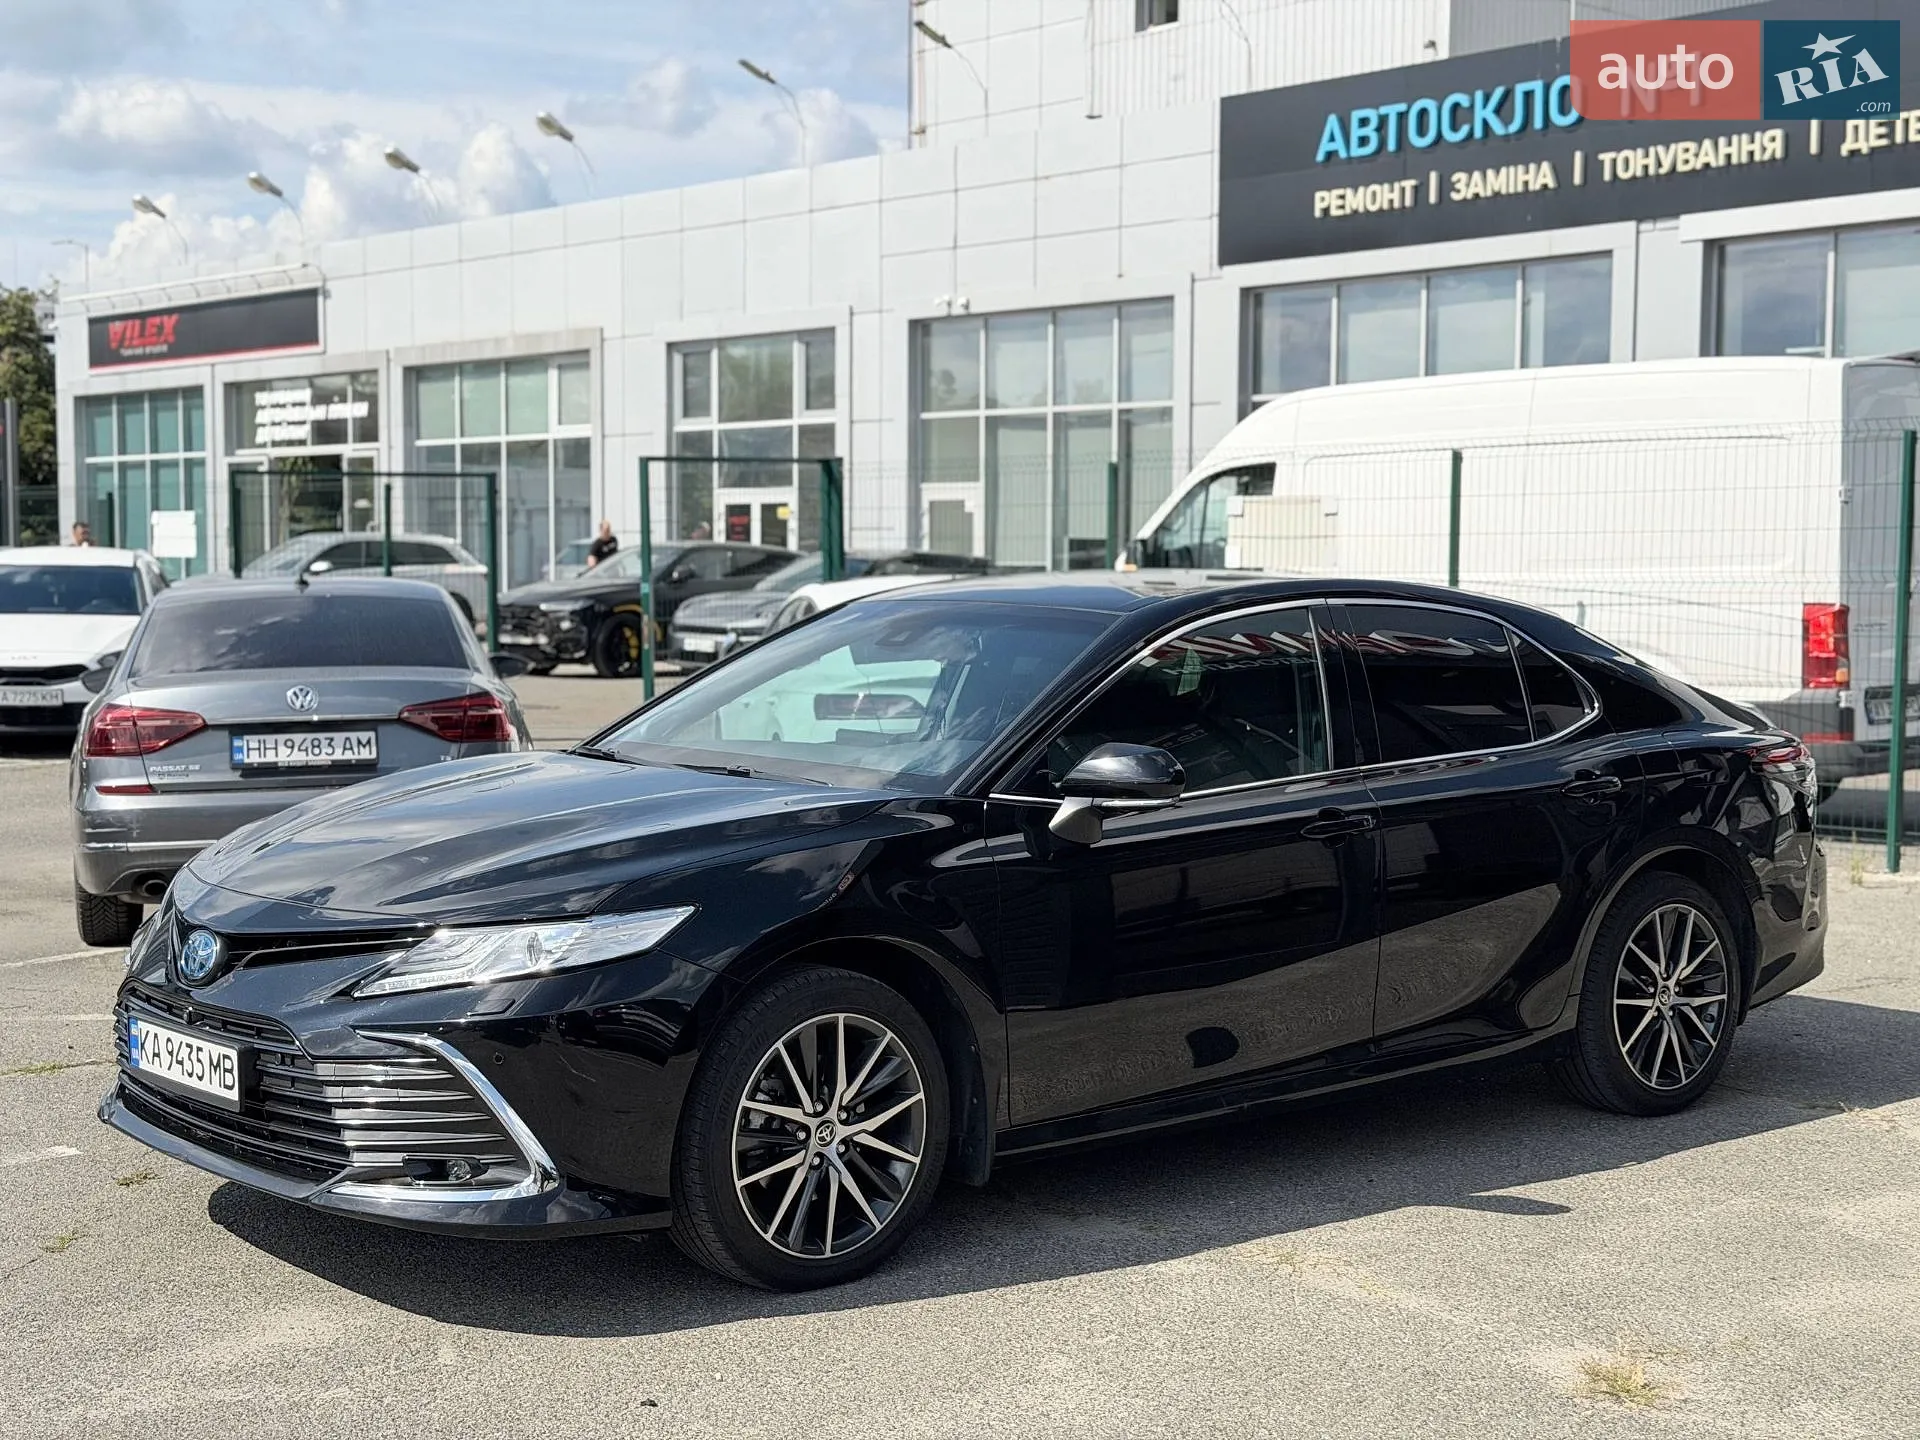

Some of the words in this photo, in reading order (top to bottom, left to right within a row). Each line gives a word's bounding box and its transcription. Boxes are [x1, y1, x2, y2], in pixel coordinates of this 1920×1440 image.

[1314, 74, 1583, 163] АВТОСКЛО
[1313, 176, 1418, 219] РЕМОНТ
[1449, 160, 1557, 202] ЗАМІНА
[1598, 127, 1786, 182] ТОНУВАННЯ
[108, 313, 180, 350] VILEX
[246, 739, 279, 759] HH
[283, 737, 335, 758] 9483
[341, 736, 372, 757] AM
[139, 1027, 162, 1069] KA
[165, 1036, 205, 1082] 9435
[208, 1048, 236, 1091] MB
